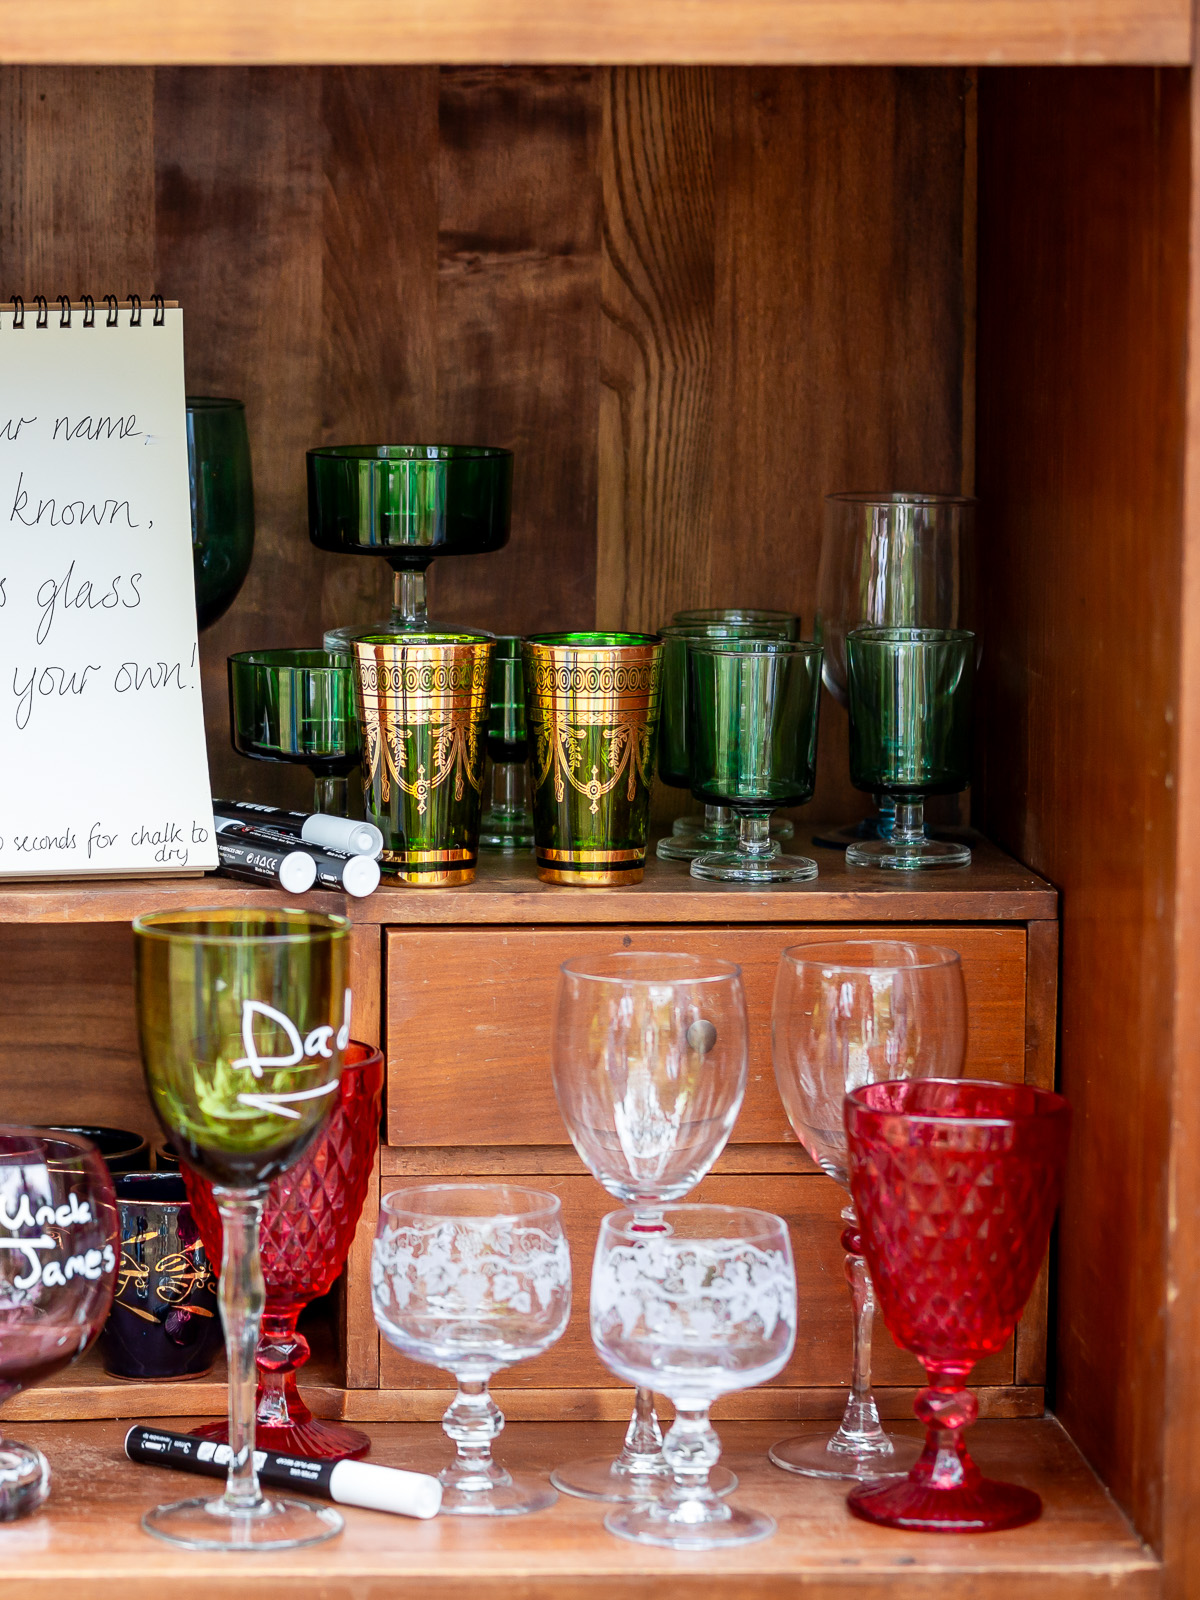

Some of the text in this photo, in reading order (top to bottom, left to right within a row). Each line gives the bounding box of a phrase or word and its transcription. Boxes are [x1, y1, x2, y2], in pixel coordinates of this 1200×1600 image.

[10, 472, 153, 530] known,
[36, 560, 142, 645] glass
[13, 665, 101, 730] your
[114, 642, 198, 693] own!
[13, 828, 77, 852] seconds
[87, 822, 118, 858] for
[131, 823, 184, 846] chalk
[191, 820, 209, 844] to
[154, 844, 189, 867] dry
[231, 988, 352, 1078] Dad
